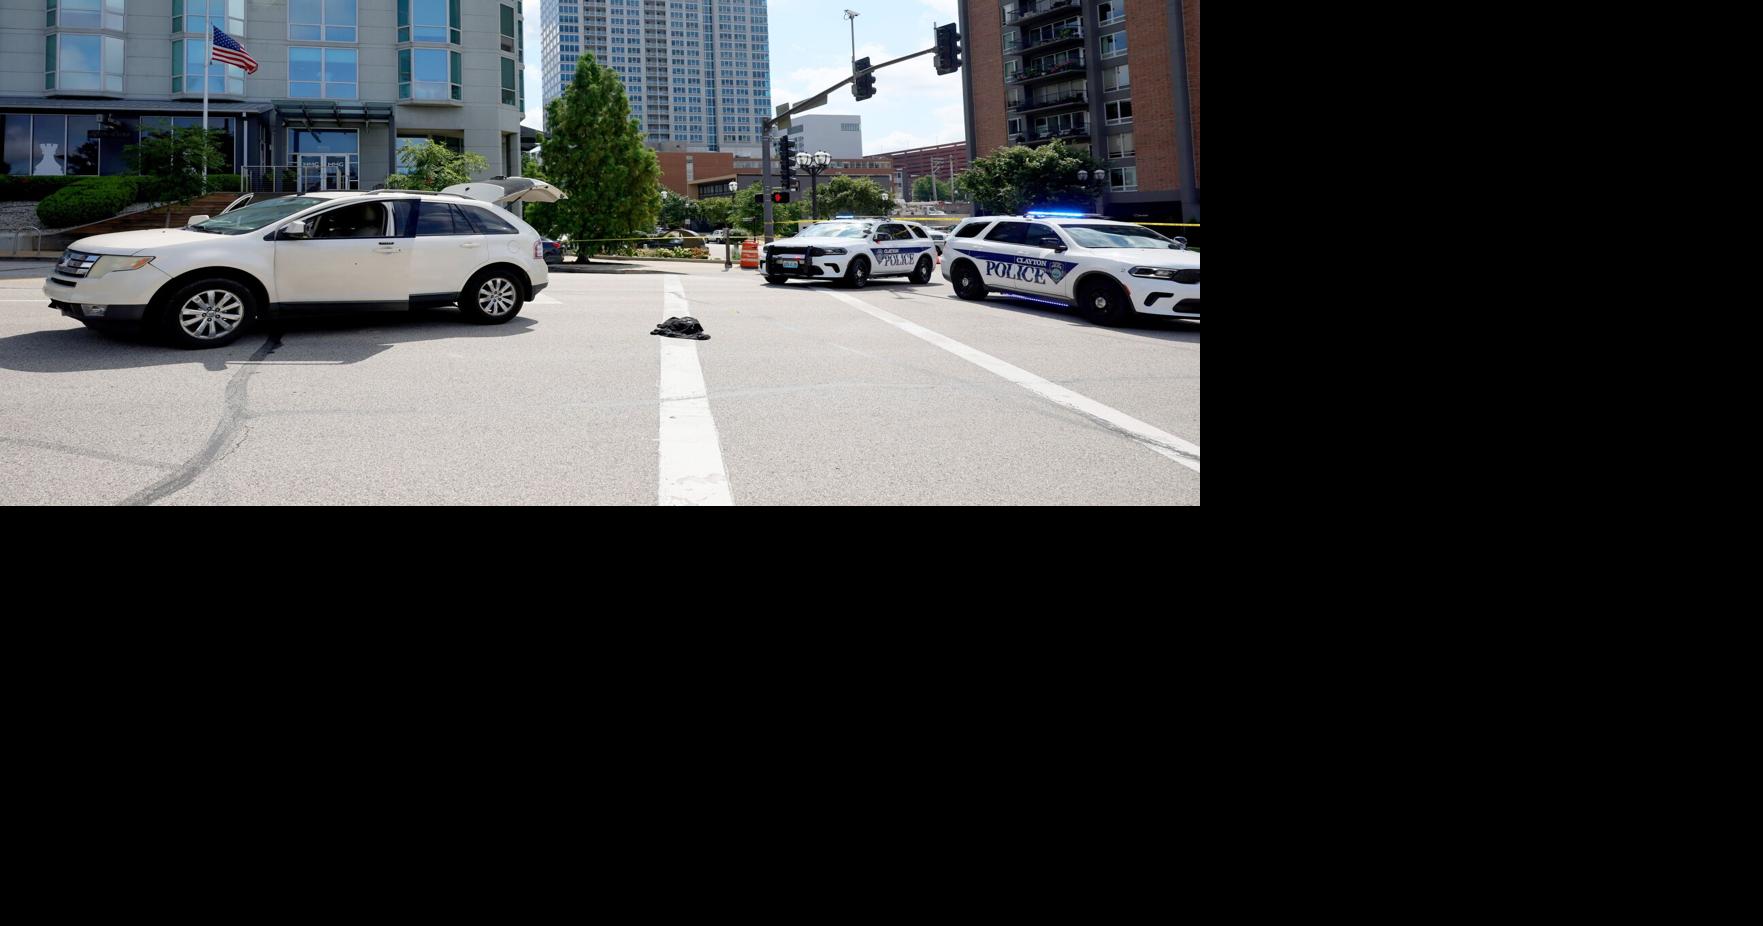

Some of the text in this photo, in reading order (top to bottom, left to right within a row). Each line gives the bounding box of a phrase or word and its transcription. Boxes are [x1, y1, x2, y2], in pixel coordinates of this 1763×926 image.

[884, 253, 914, 266] POLICE
[1016, 257, 1047, 267] CLAYTON
[986, 260, 1046, 284] POLICE
